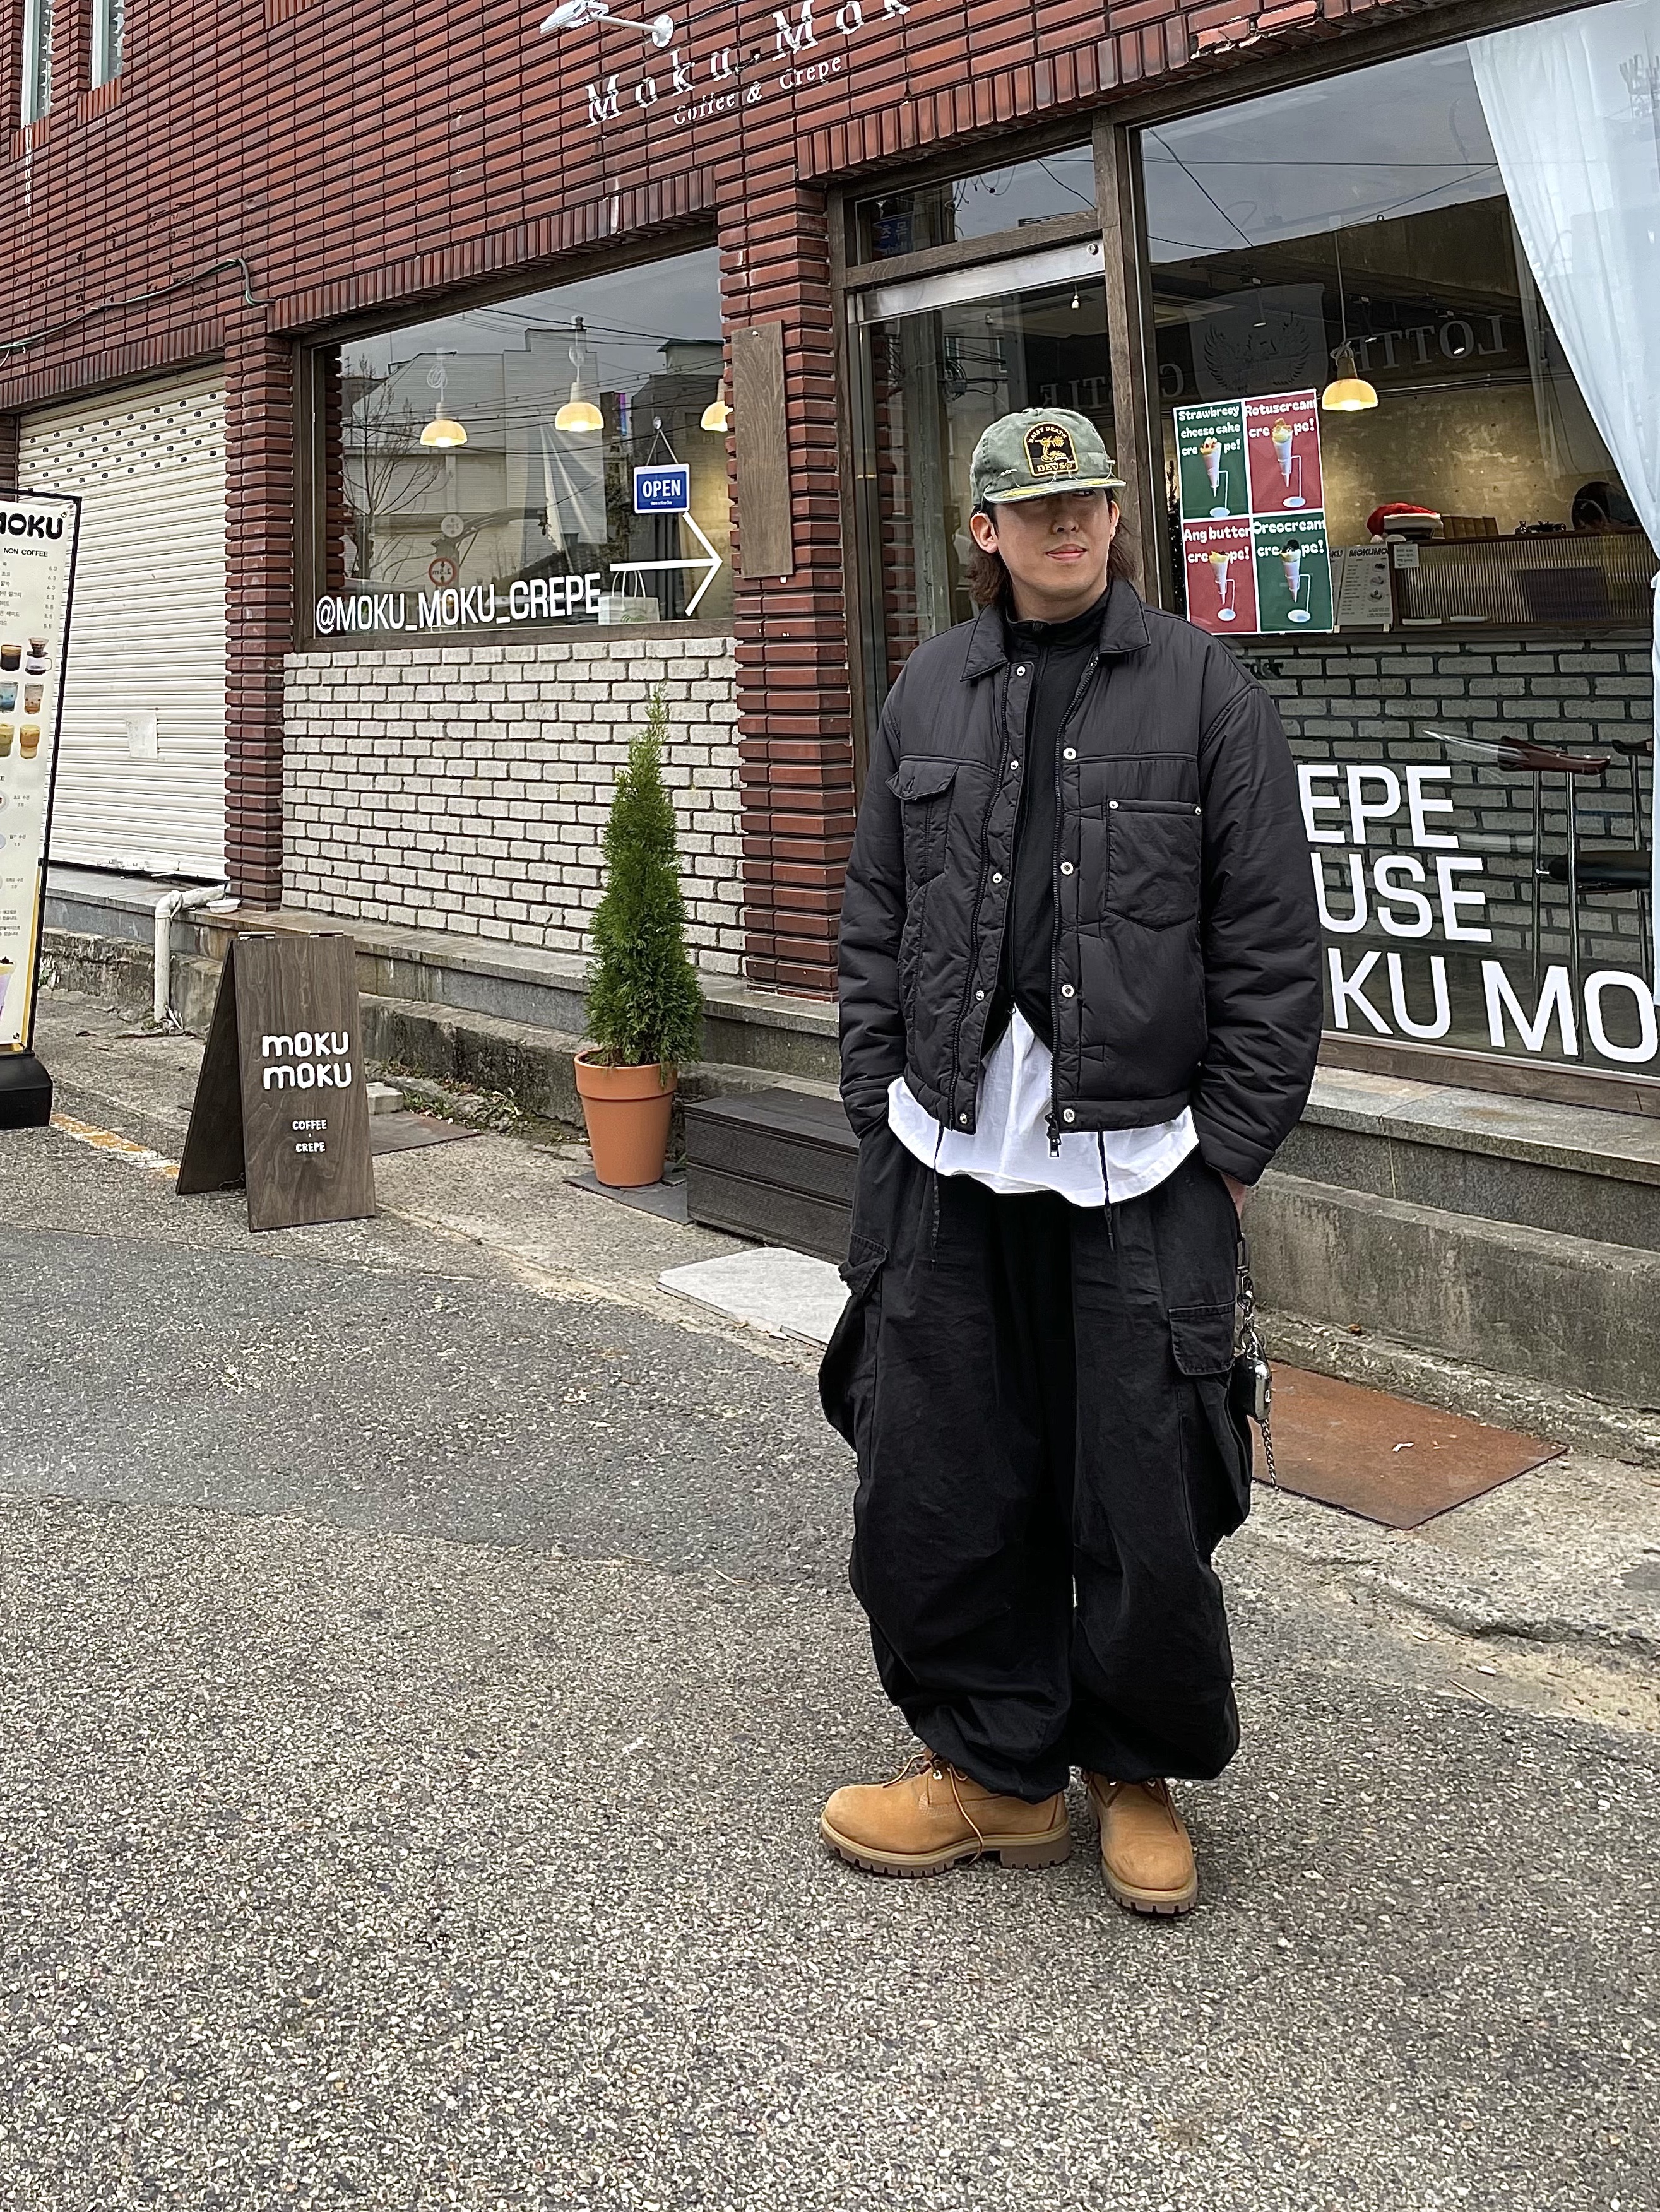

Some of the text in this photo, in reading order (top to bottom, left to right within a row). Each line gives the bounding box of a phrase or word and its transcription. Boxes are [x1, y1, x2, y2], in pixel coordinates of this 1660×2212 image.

[673, 56, 842, 125] Coffee & Crepe
[1180, 422, 1240, 439] cheese cake
[643, 479, 681, 498] OPEN
[1183, 526, 1250, 544] Ang butter
[316, 572, 601, 634] @MOKU_MOKU_CREPE
[1480, 959, 1659, 1063] MO
[292, 1120, 328, 1130] COFFEE
[295, 1142, 326, 1152] CREPE
